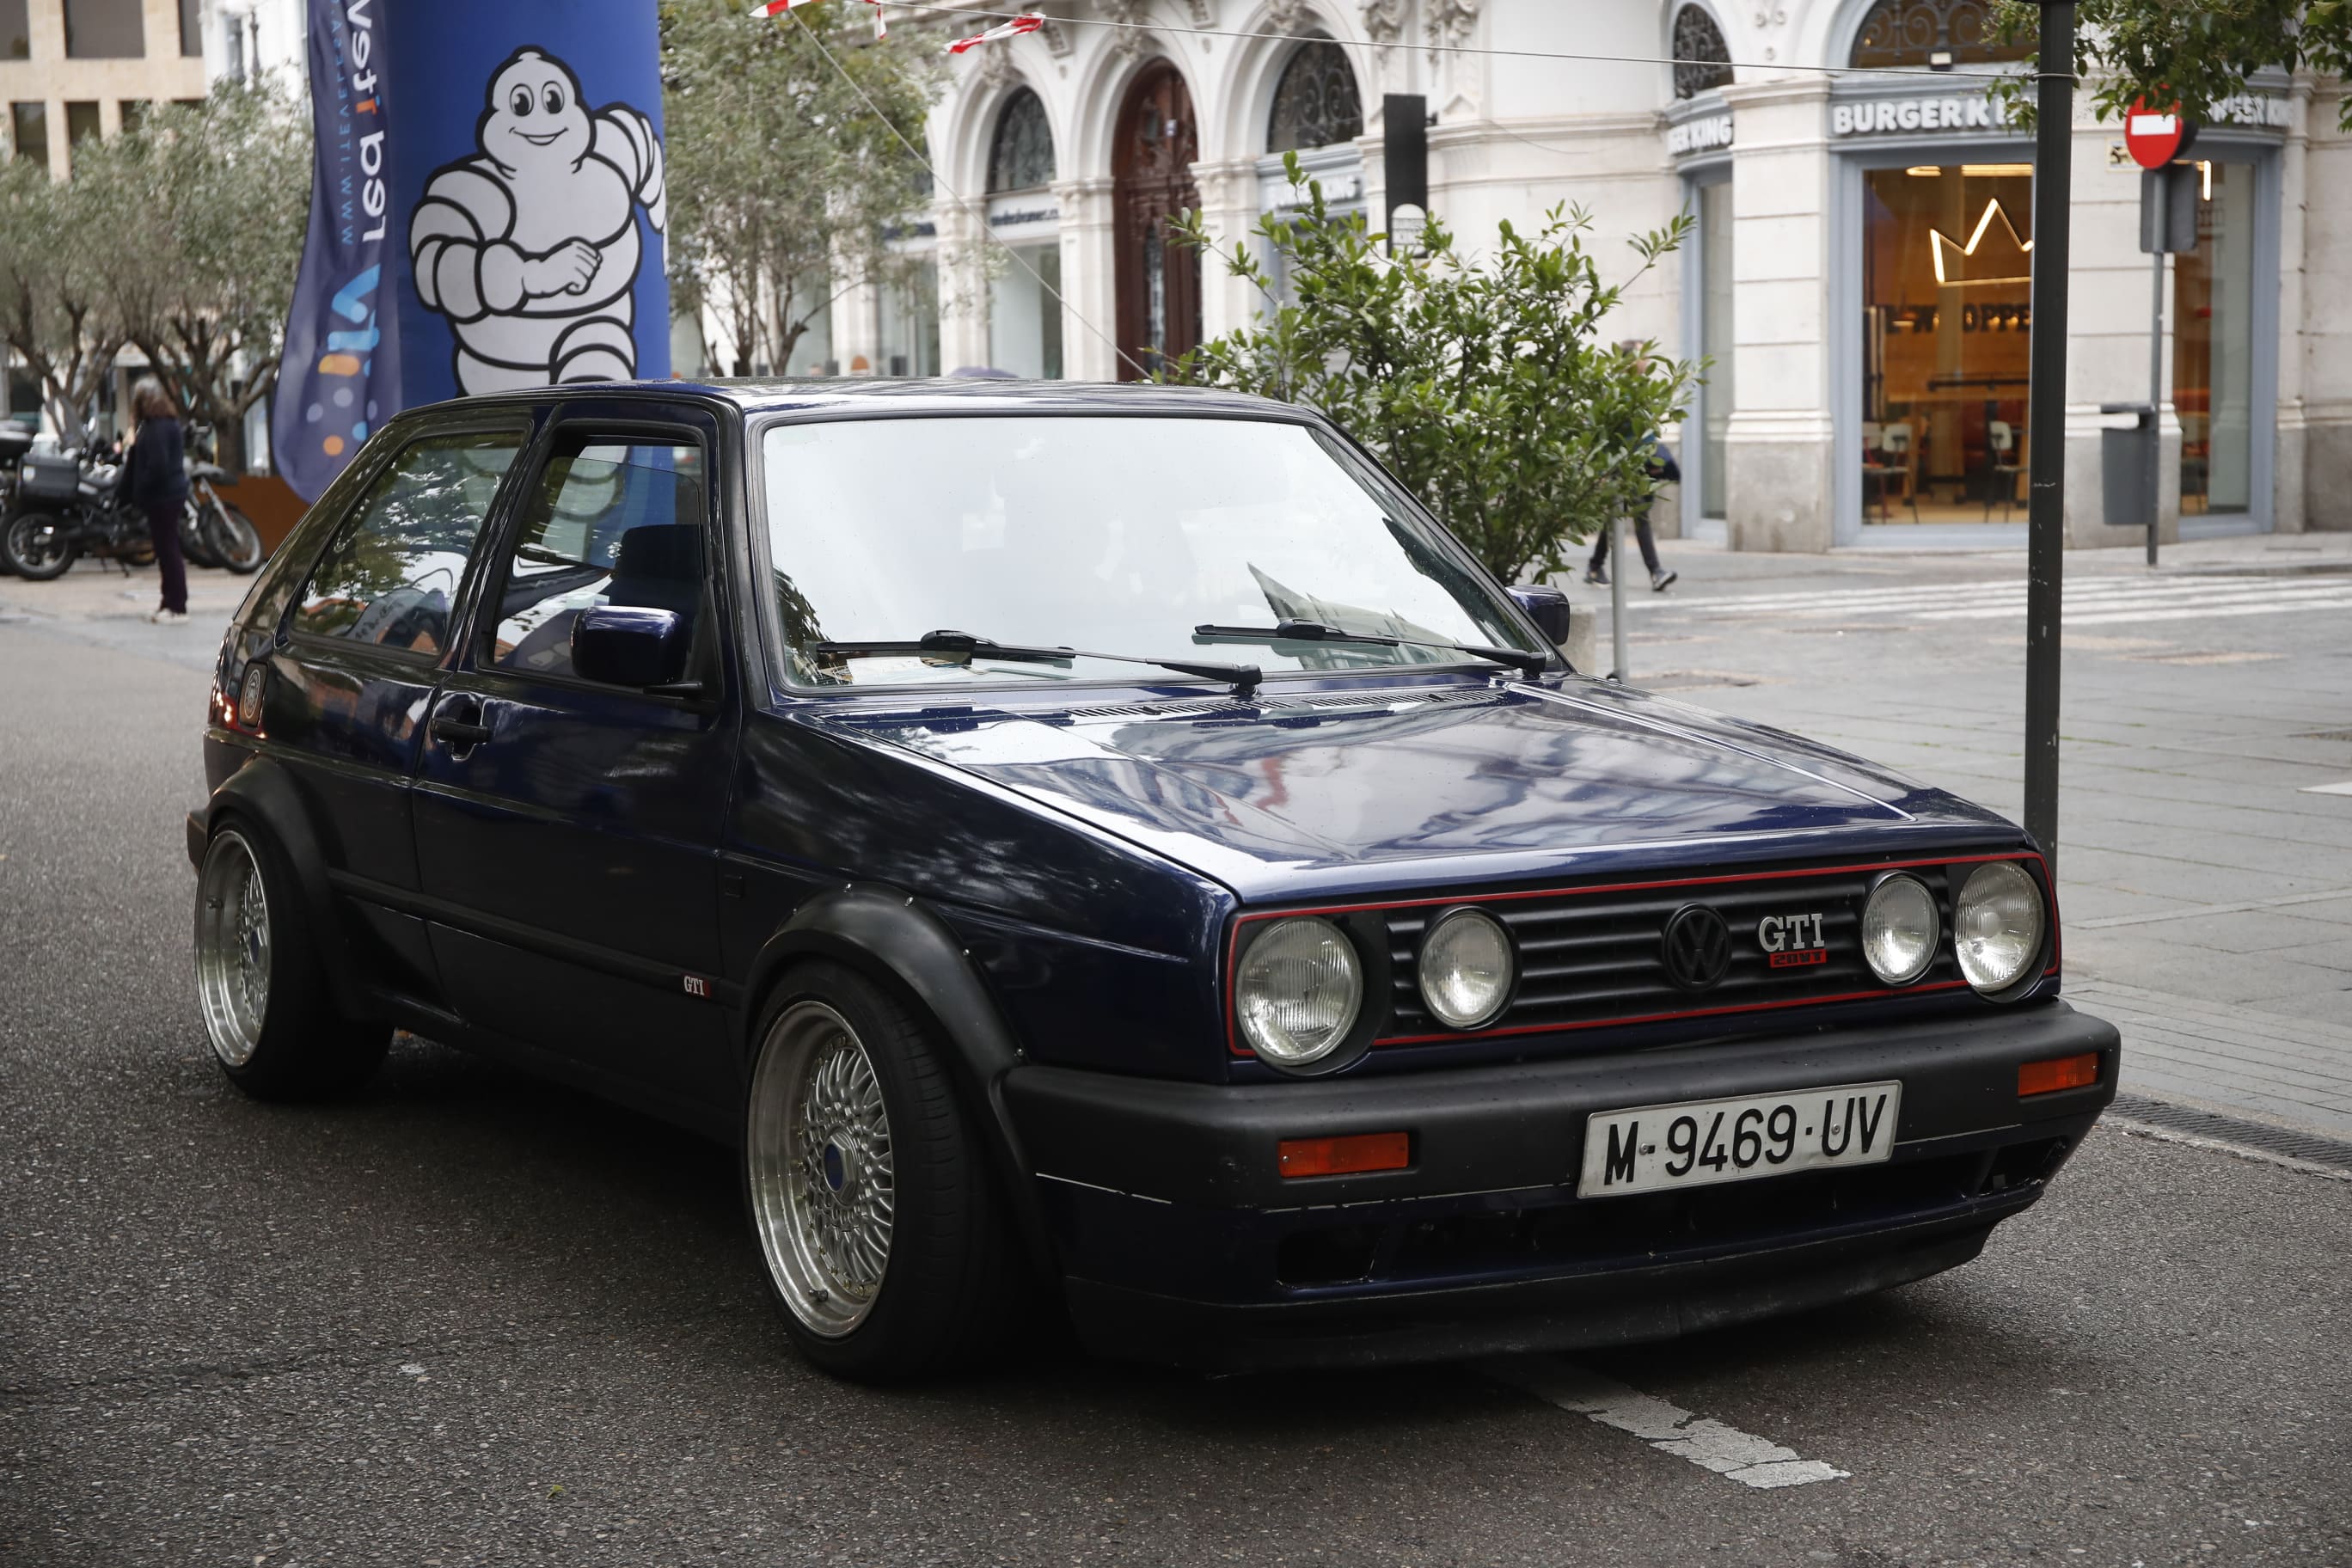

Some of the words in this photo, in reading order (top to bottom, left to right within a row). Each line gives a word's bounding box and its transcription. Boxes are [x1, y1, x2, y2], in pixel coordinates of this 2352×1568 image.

[1833, 98, 1963, 135] BURGER
[1758, 913, 1825, 952] GTI
[683, 976, 705, 995] GTI
